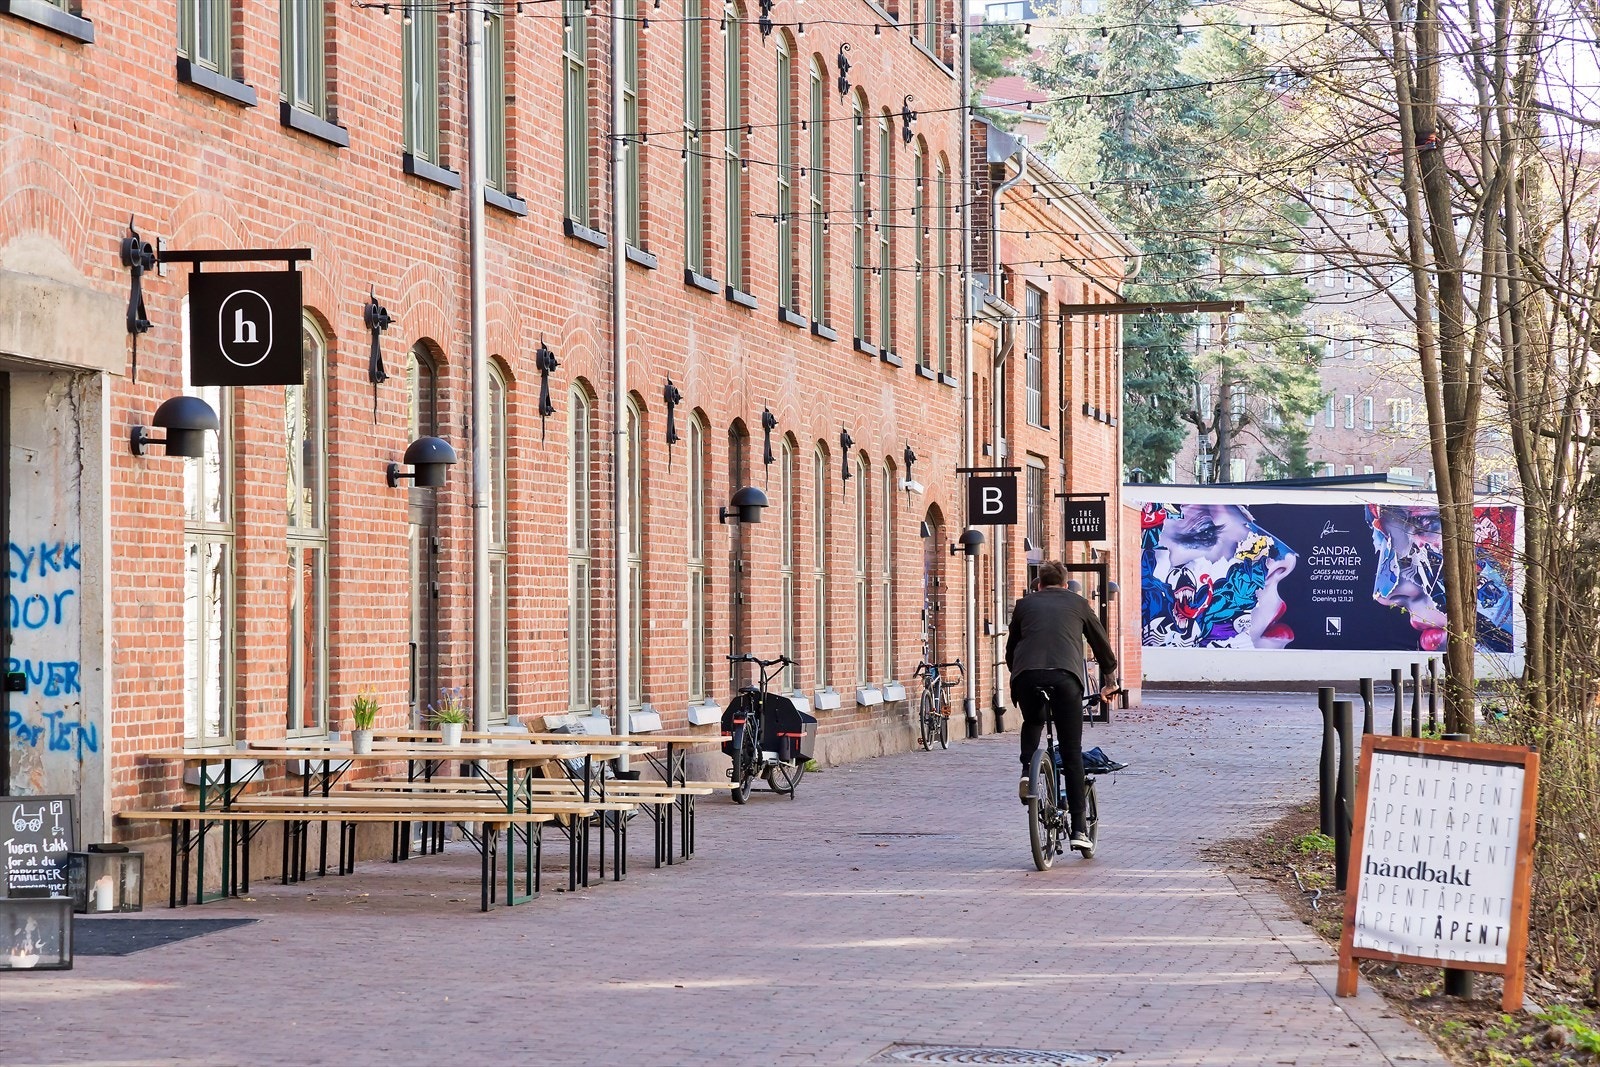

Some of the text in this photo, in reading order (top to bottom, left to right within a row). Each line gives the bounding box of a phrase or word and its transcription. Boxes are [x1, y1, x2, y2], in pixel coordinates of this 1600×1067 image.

[232, 308, 259, 343] h
[982, 486, 1004, 515] B
[1307, 556, 1362, 566] CHEVRIER
[1312, 545, 1358, 555] SANDRA
[1373, 767, 1440, 799] ÅPENT
[1448, 776, 1516, 808] ÅPENT
[1369, 797, 1514, 838] ÅPENT ÅPENT
[4, 838, 68, 855] Tusen takk
[1367, 824, 1511, 866] ÅPENT ÅPENT
[8, 856, 23, 869] for
[41, 856, 56, 866] du
[1364, 854, 1472, 887] håndbakt
[1361, 877, 1506, 918] ÅPENT ÅPENT
[1358, 905, 1426, 936] ÅPENT
[1434, 914, 1503, 946] ÅPENT
